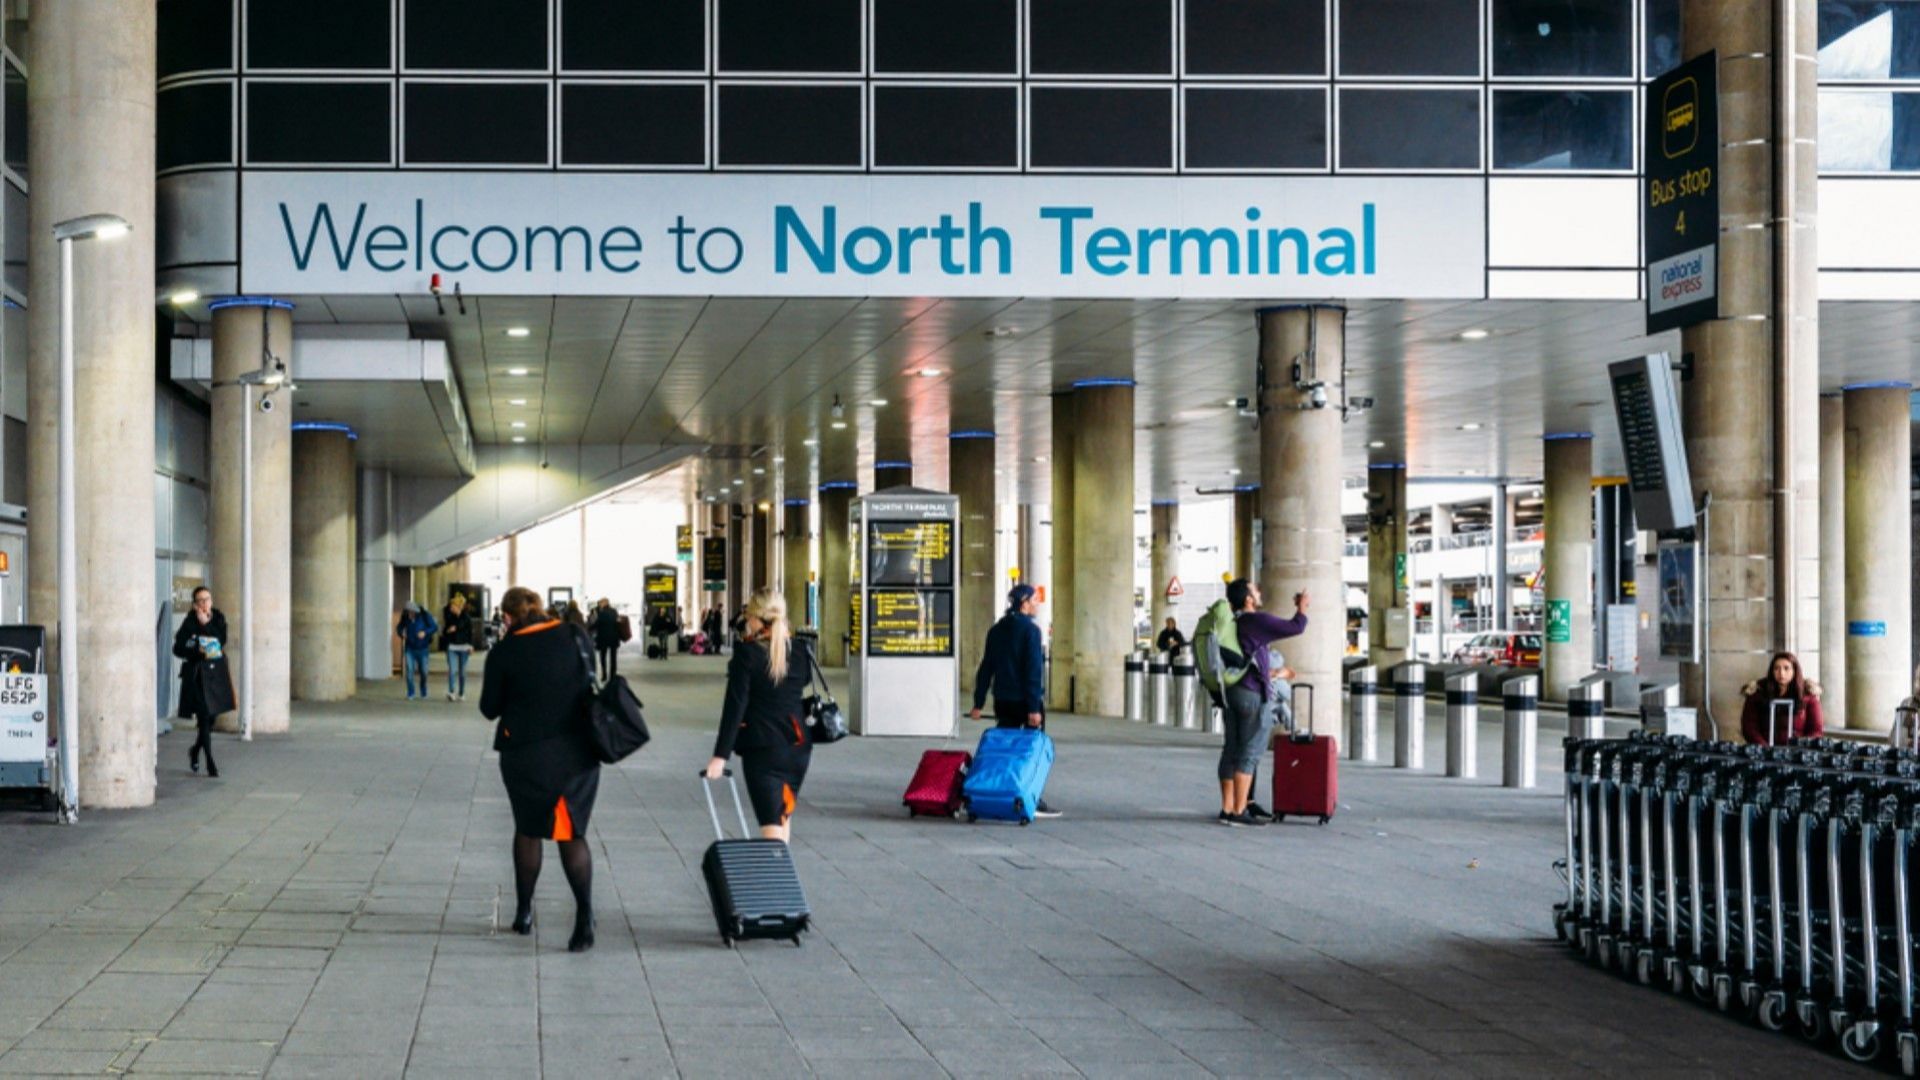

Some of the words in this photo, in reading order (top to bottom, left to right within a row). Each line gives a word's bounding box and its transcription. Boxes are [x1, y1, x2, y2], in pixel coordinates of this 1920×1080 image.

[1651, 178, 1676, 208] Bus
[1679, 167, 1711, 197] stop
[1674, 209, 1687, 236] 4
[279, 198, 642, 273] Welcome
[667, 215, 744, 274] to
[773, 201, 1012, 275] North
[1039, 202, 1376, 276] Terminal
[1660, 254, 1703, 285] national
[1661, 276, 1703, 301] express
[5, 676, 34, 691] LFG
[1, 690, 38, 705] 652P
